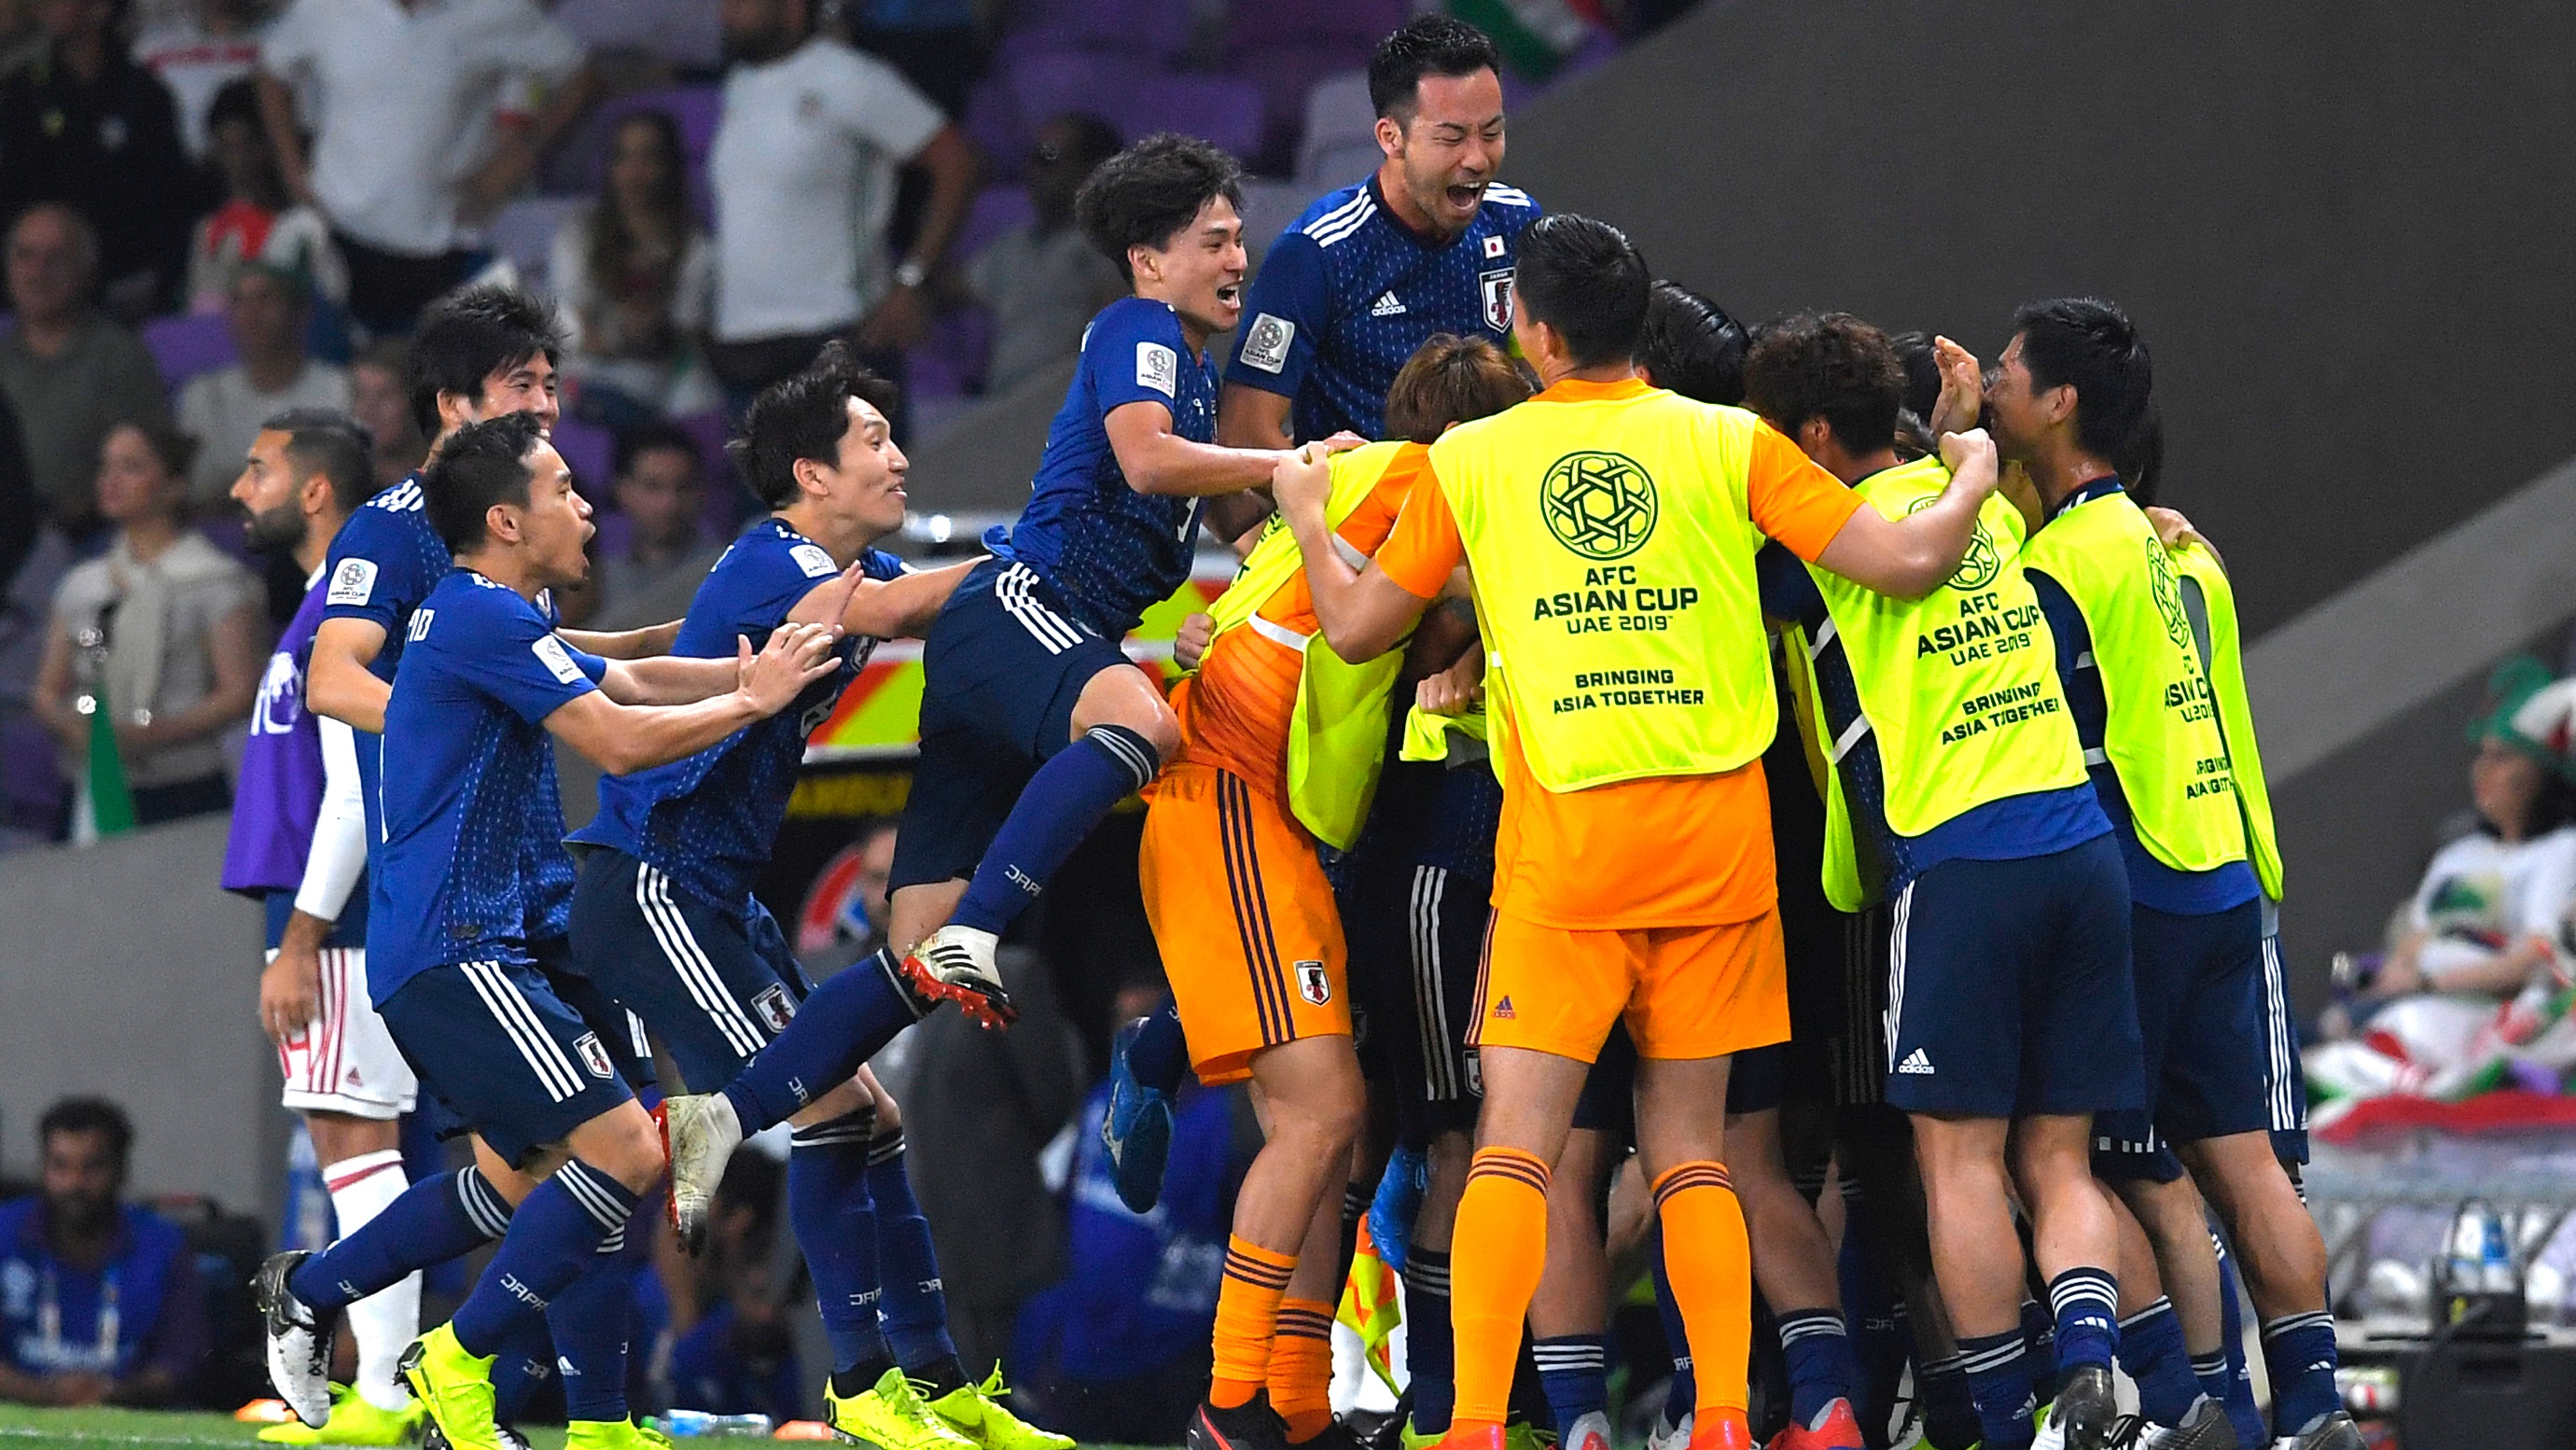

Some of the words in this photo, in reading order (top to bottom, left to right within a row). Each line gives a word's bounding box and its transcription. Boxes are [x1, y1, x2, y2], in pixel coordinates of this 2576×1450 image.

[1372, 303, 1407, 317] adidas
[1585, 565, 1636, 587] AFC
[1534, 589, 1628, 621] ASIAN
[1636, 587, 1698, 611] CUP
[1960, 592, 1999, 619] AFC
[1566, 616, 1613, 635] UAE
[1917, 615, 2001, 660] ASIAN
[2002, 605, 2040, 632] CUP
[1950, 643, 1992, 667] UAE
[1575, 670, 1674, 689] BRINGING
[1553, 694, 1597, 715] ASIA
[1599, 690, 1705, 707] TOGETHER
[1942, 718, 1988, 746] ASIA
[1898, 1064, 1935, 1075] adidas
